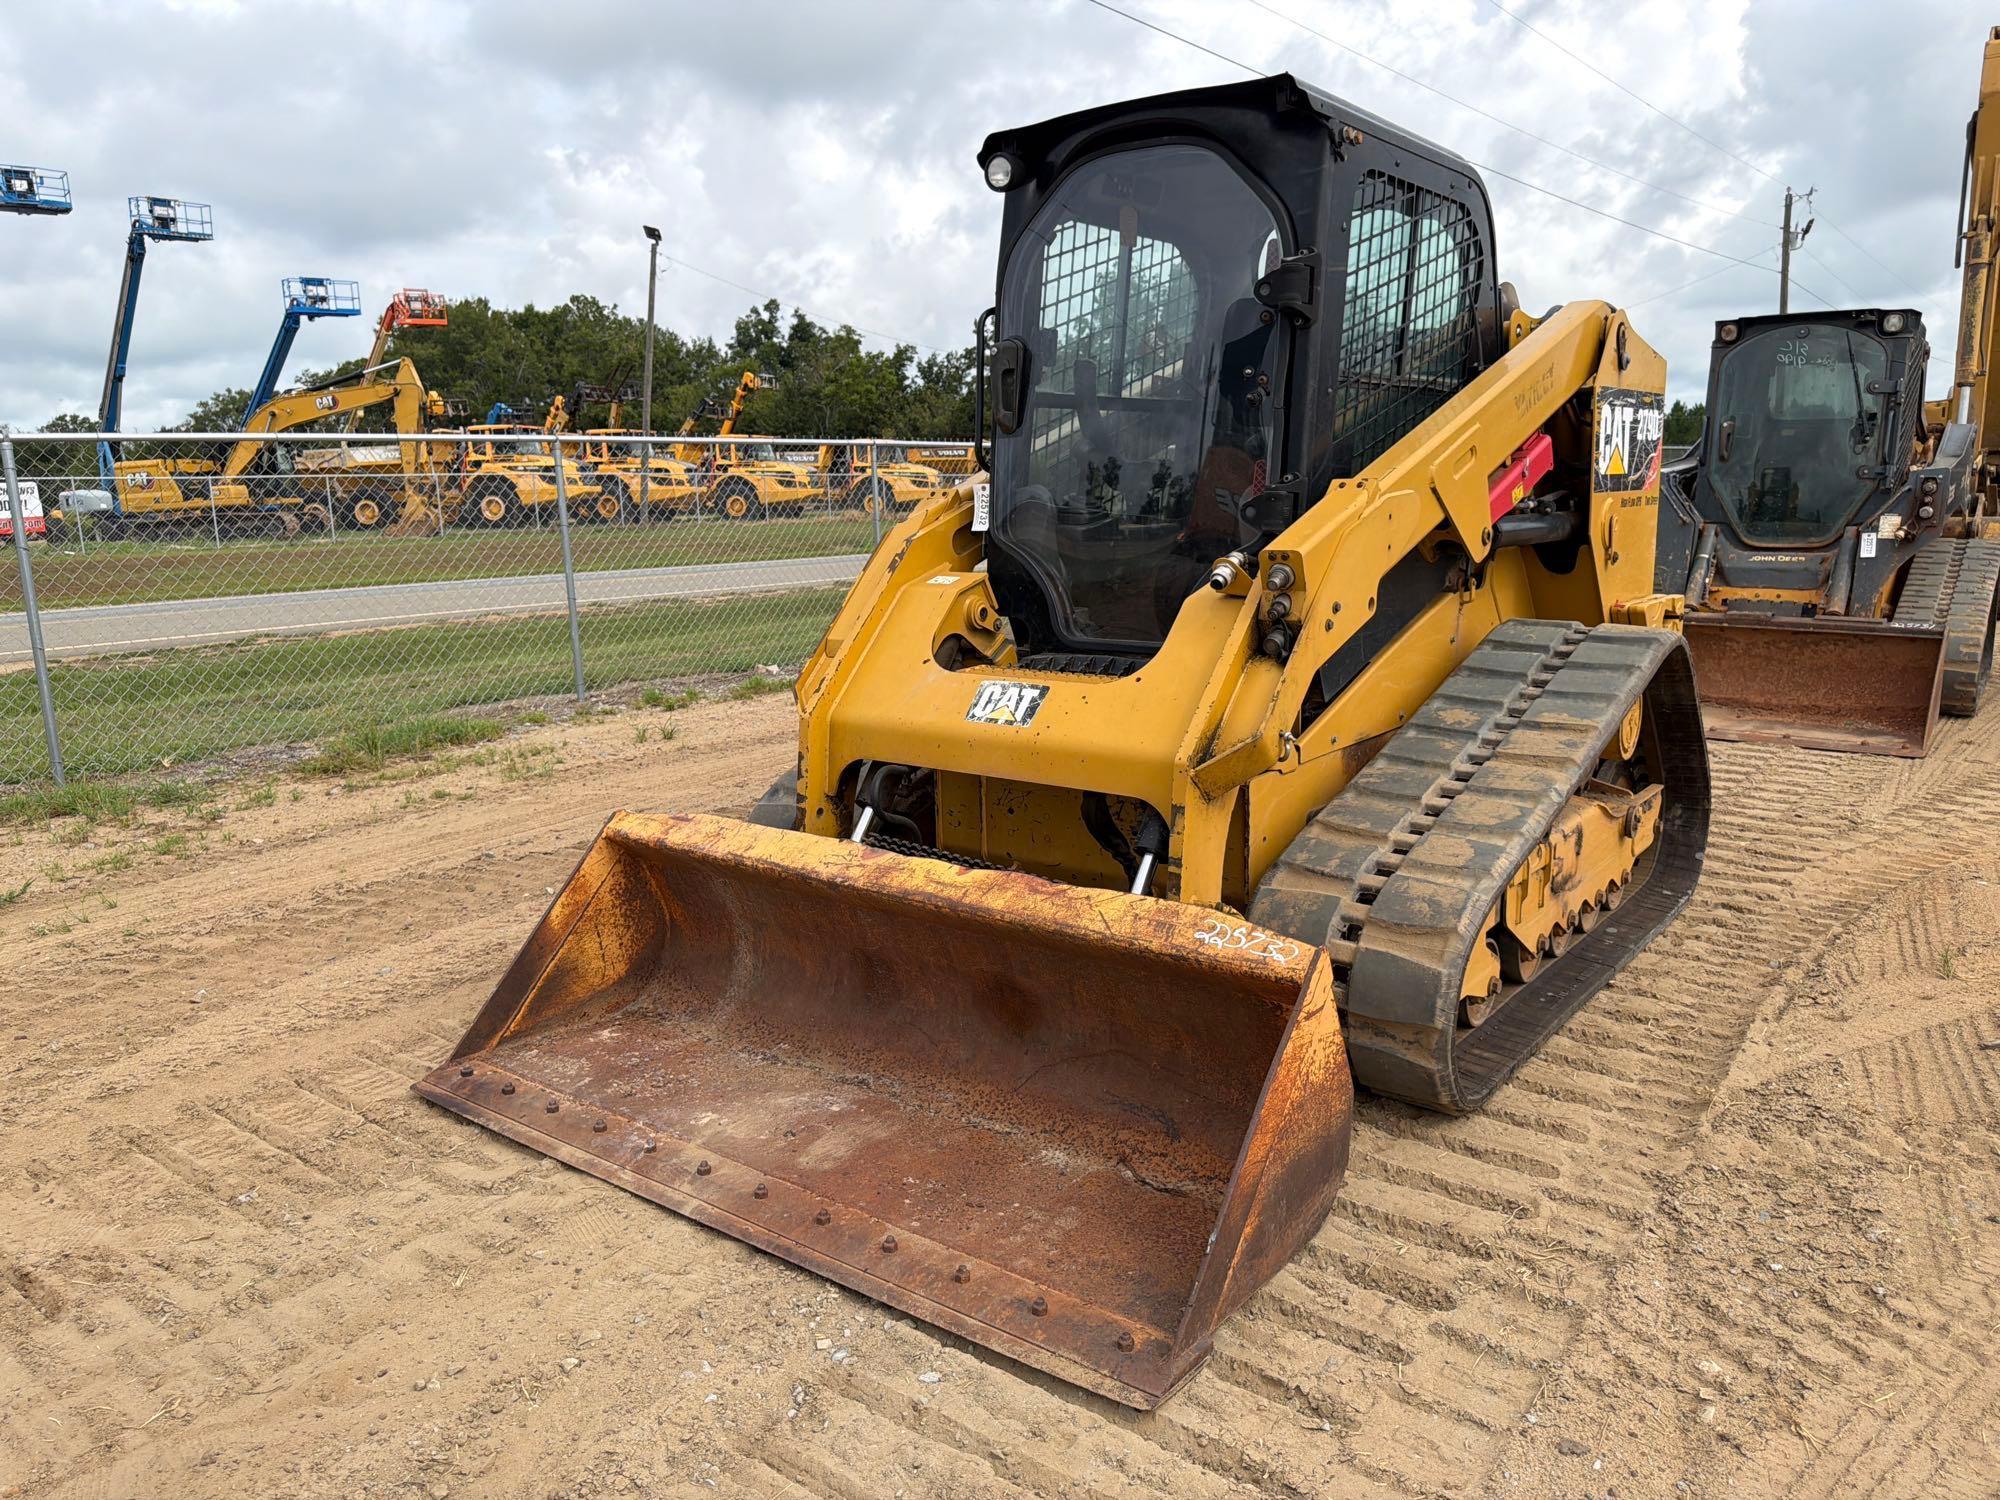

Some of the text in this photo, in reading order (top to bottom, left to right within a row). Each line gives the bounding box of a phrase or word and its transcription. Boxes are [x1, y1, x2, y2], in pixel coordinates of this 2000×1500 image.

[316, 396, 334, 409] CAT
[1599, 404, 1634, 475] CAT
[127, 471, 148, 487] CAT
[978, 493, 989, 526] 225732
[973, 685, 1041, 724] CAT
[1194, 918, 1299, 965] 225732
